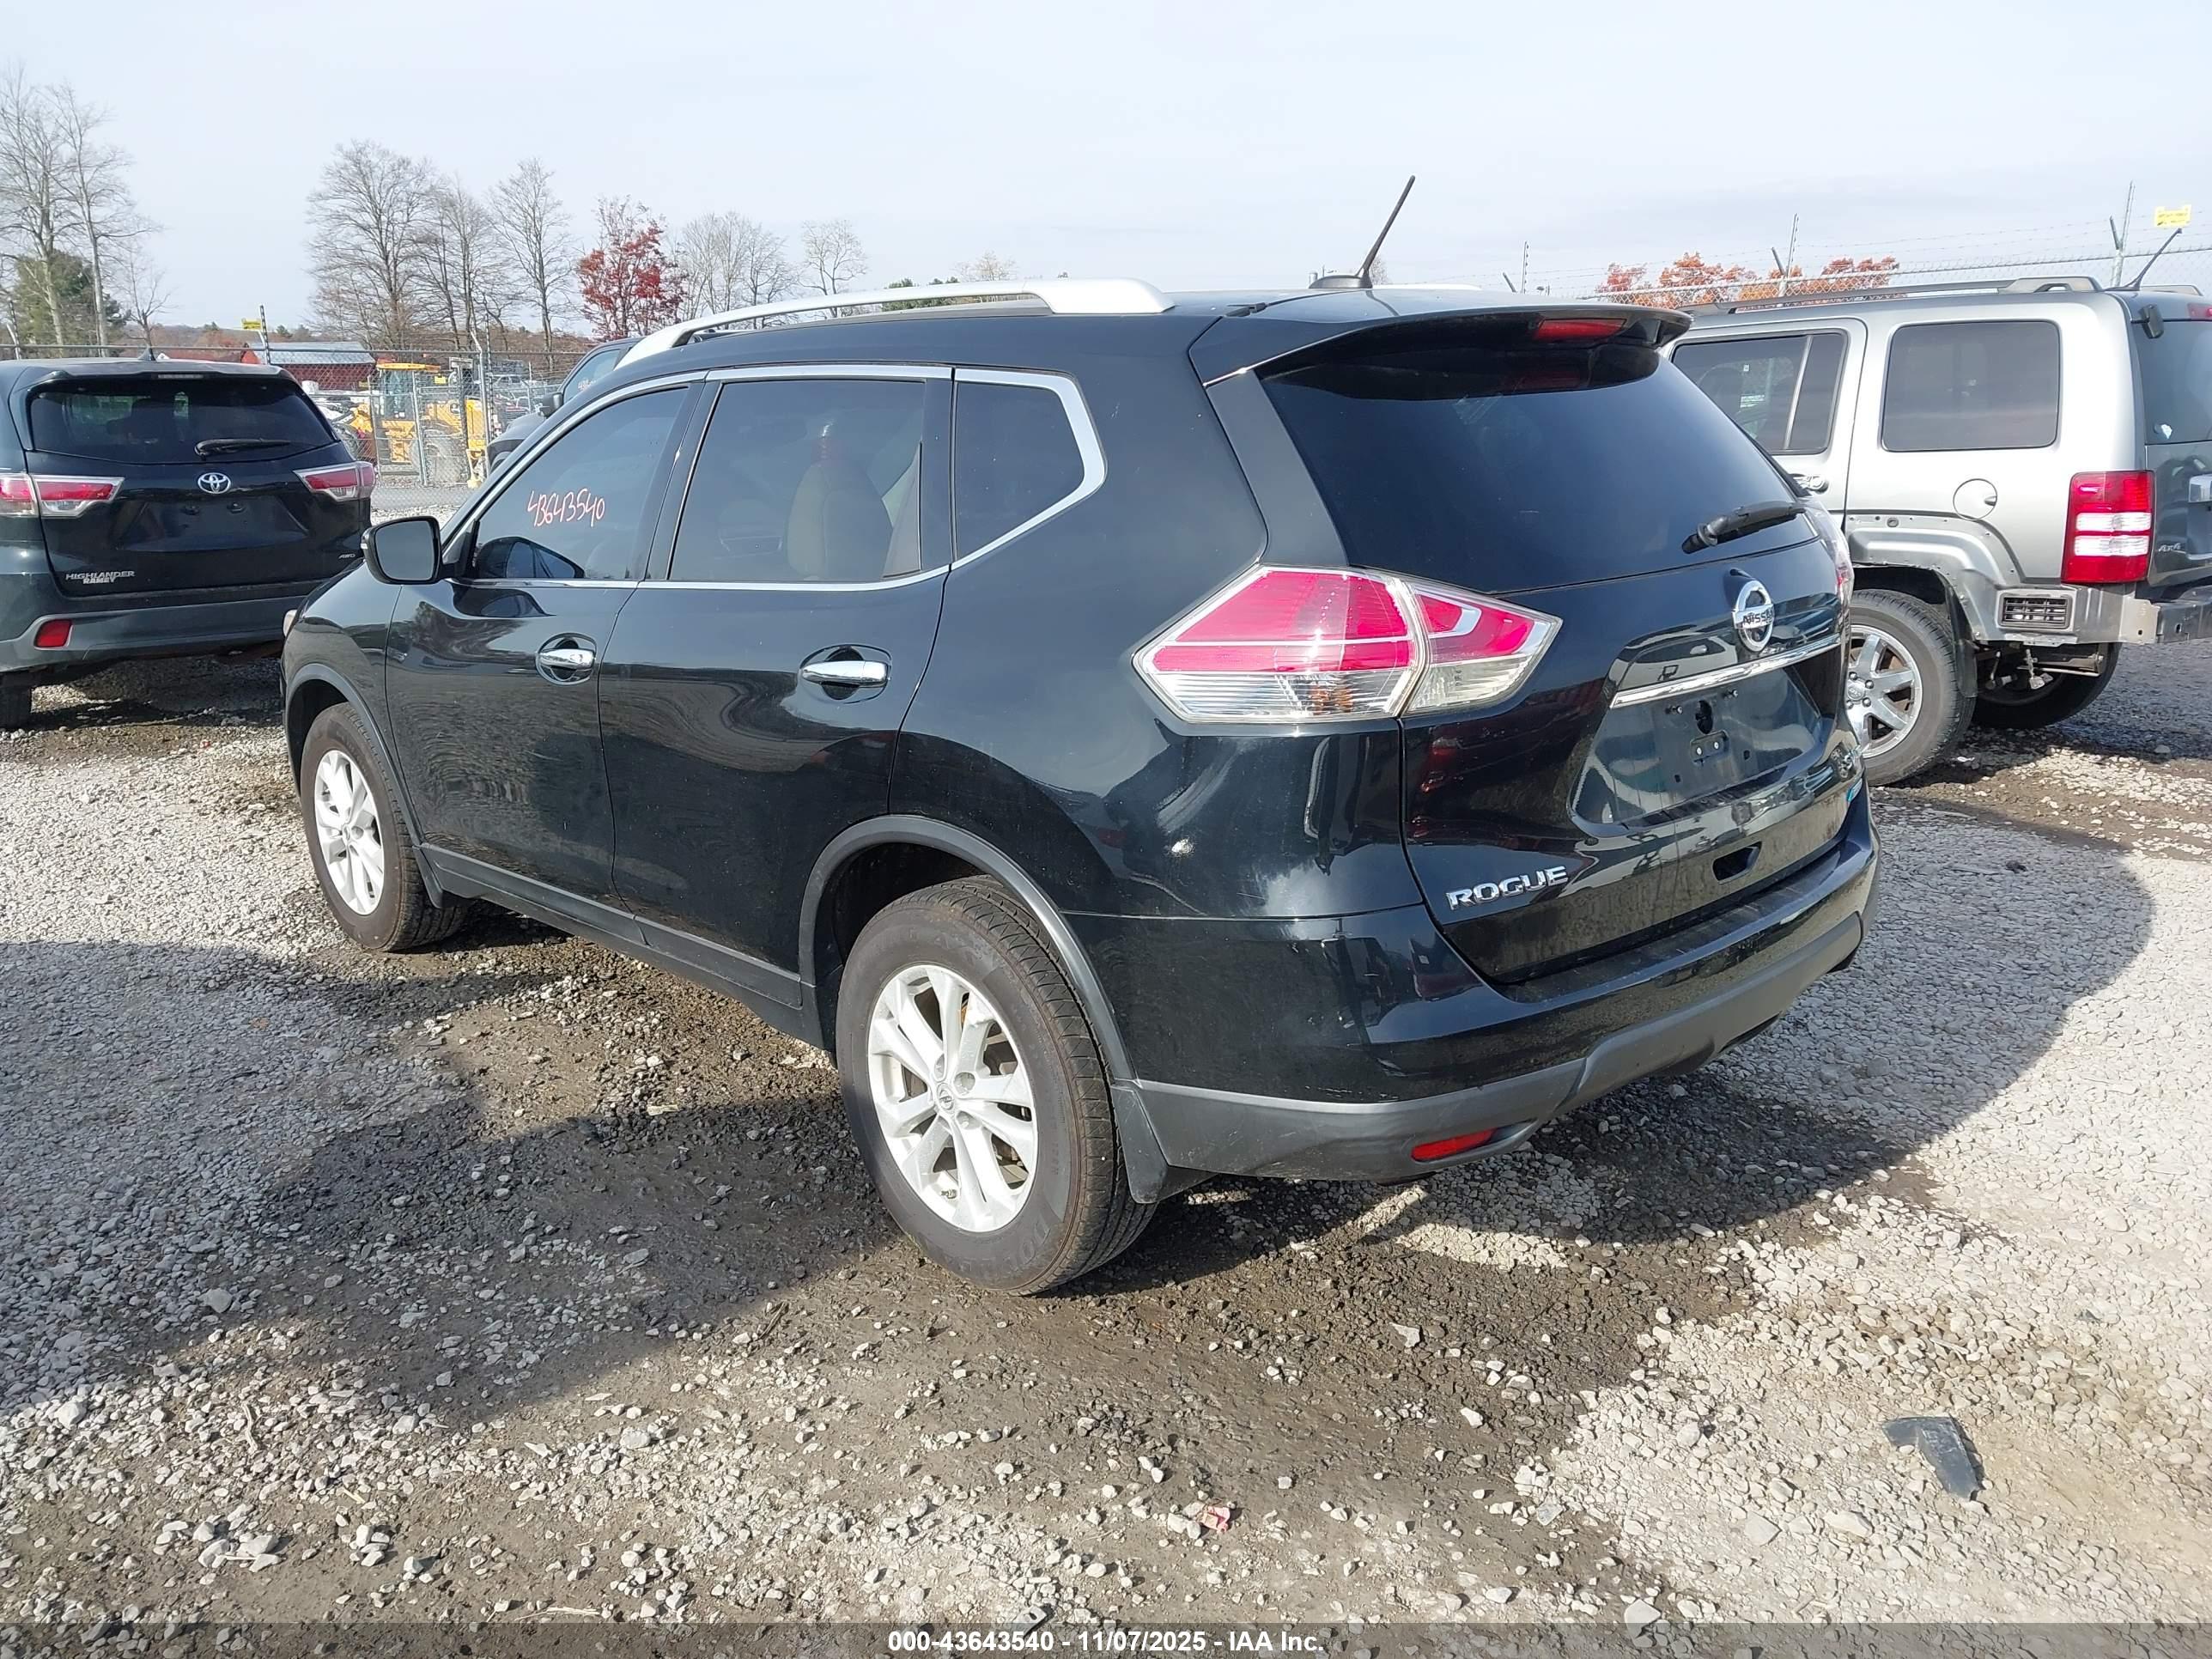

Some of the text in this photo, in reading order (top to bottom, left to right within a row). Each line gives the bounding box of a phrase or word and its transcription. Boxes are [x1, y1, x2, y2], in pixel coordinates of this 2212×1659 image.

[527, 488, 605, 527] 43643540
[65, 570, 136, 580] HIGHLANDER
[1446, 866, 1569, 910] ROGUE
